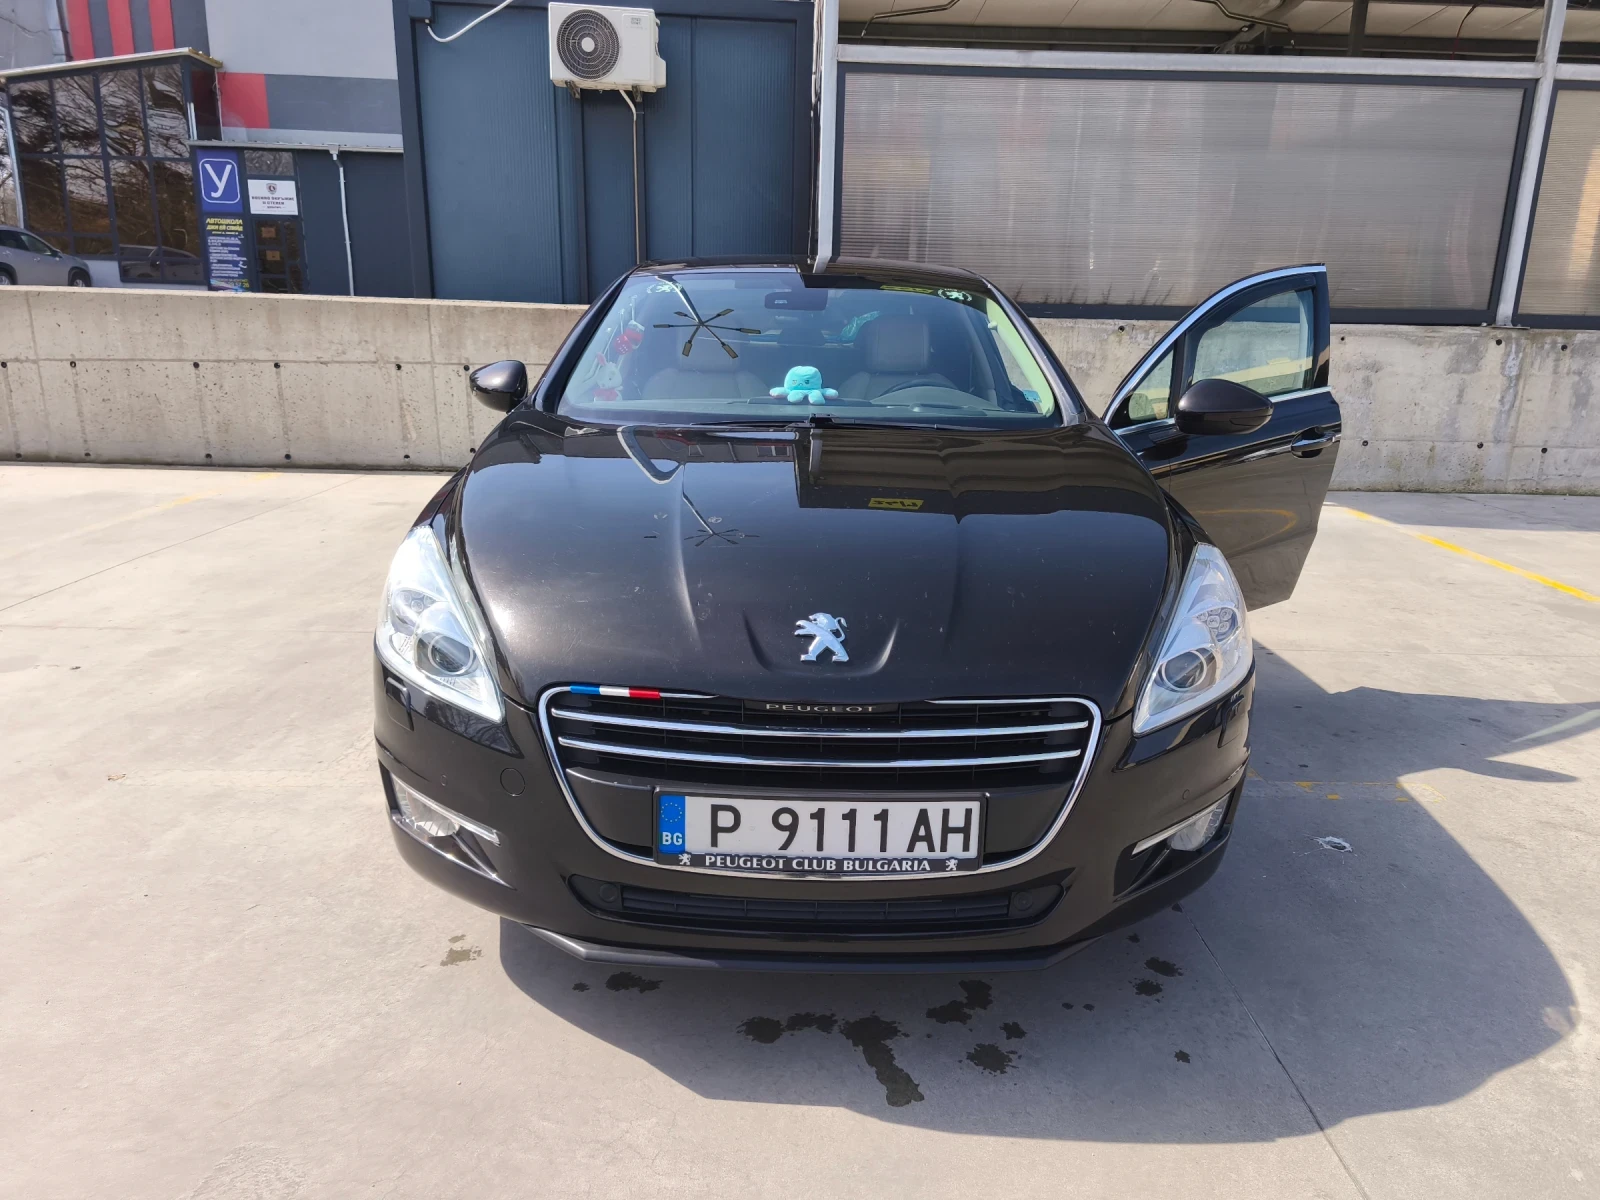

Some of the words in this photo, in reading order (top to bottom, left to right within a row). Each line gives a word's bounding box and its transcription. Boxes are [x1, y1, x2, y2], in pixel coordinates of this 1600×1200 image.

[765, 703, 877, 713] PEUGEOT
[710, 803, 742, 848] P
[662, 831, 683, 846] BG
[704, 854, 786, 870] PEUGEOT
[791, 857, 837, 871] CLUB
[842, 858, 931, 873] BULGARIA
